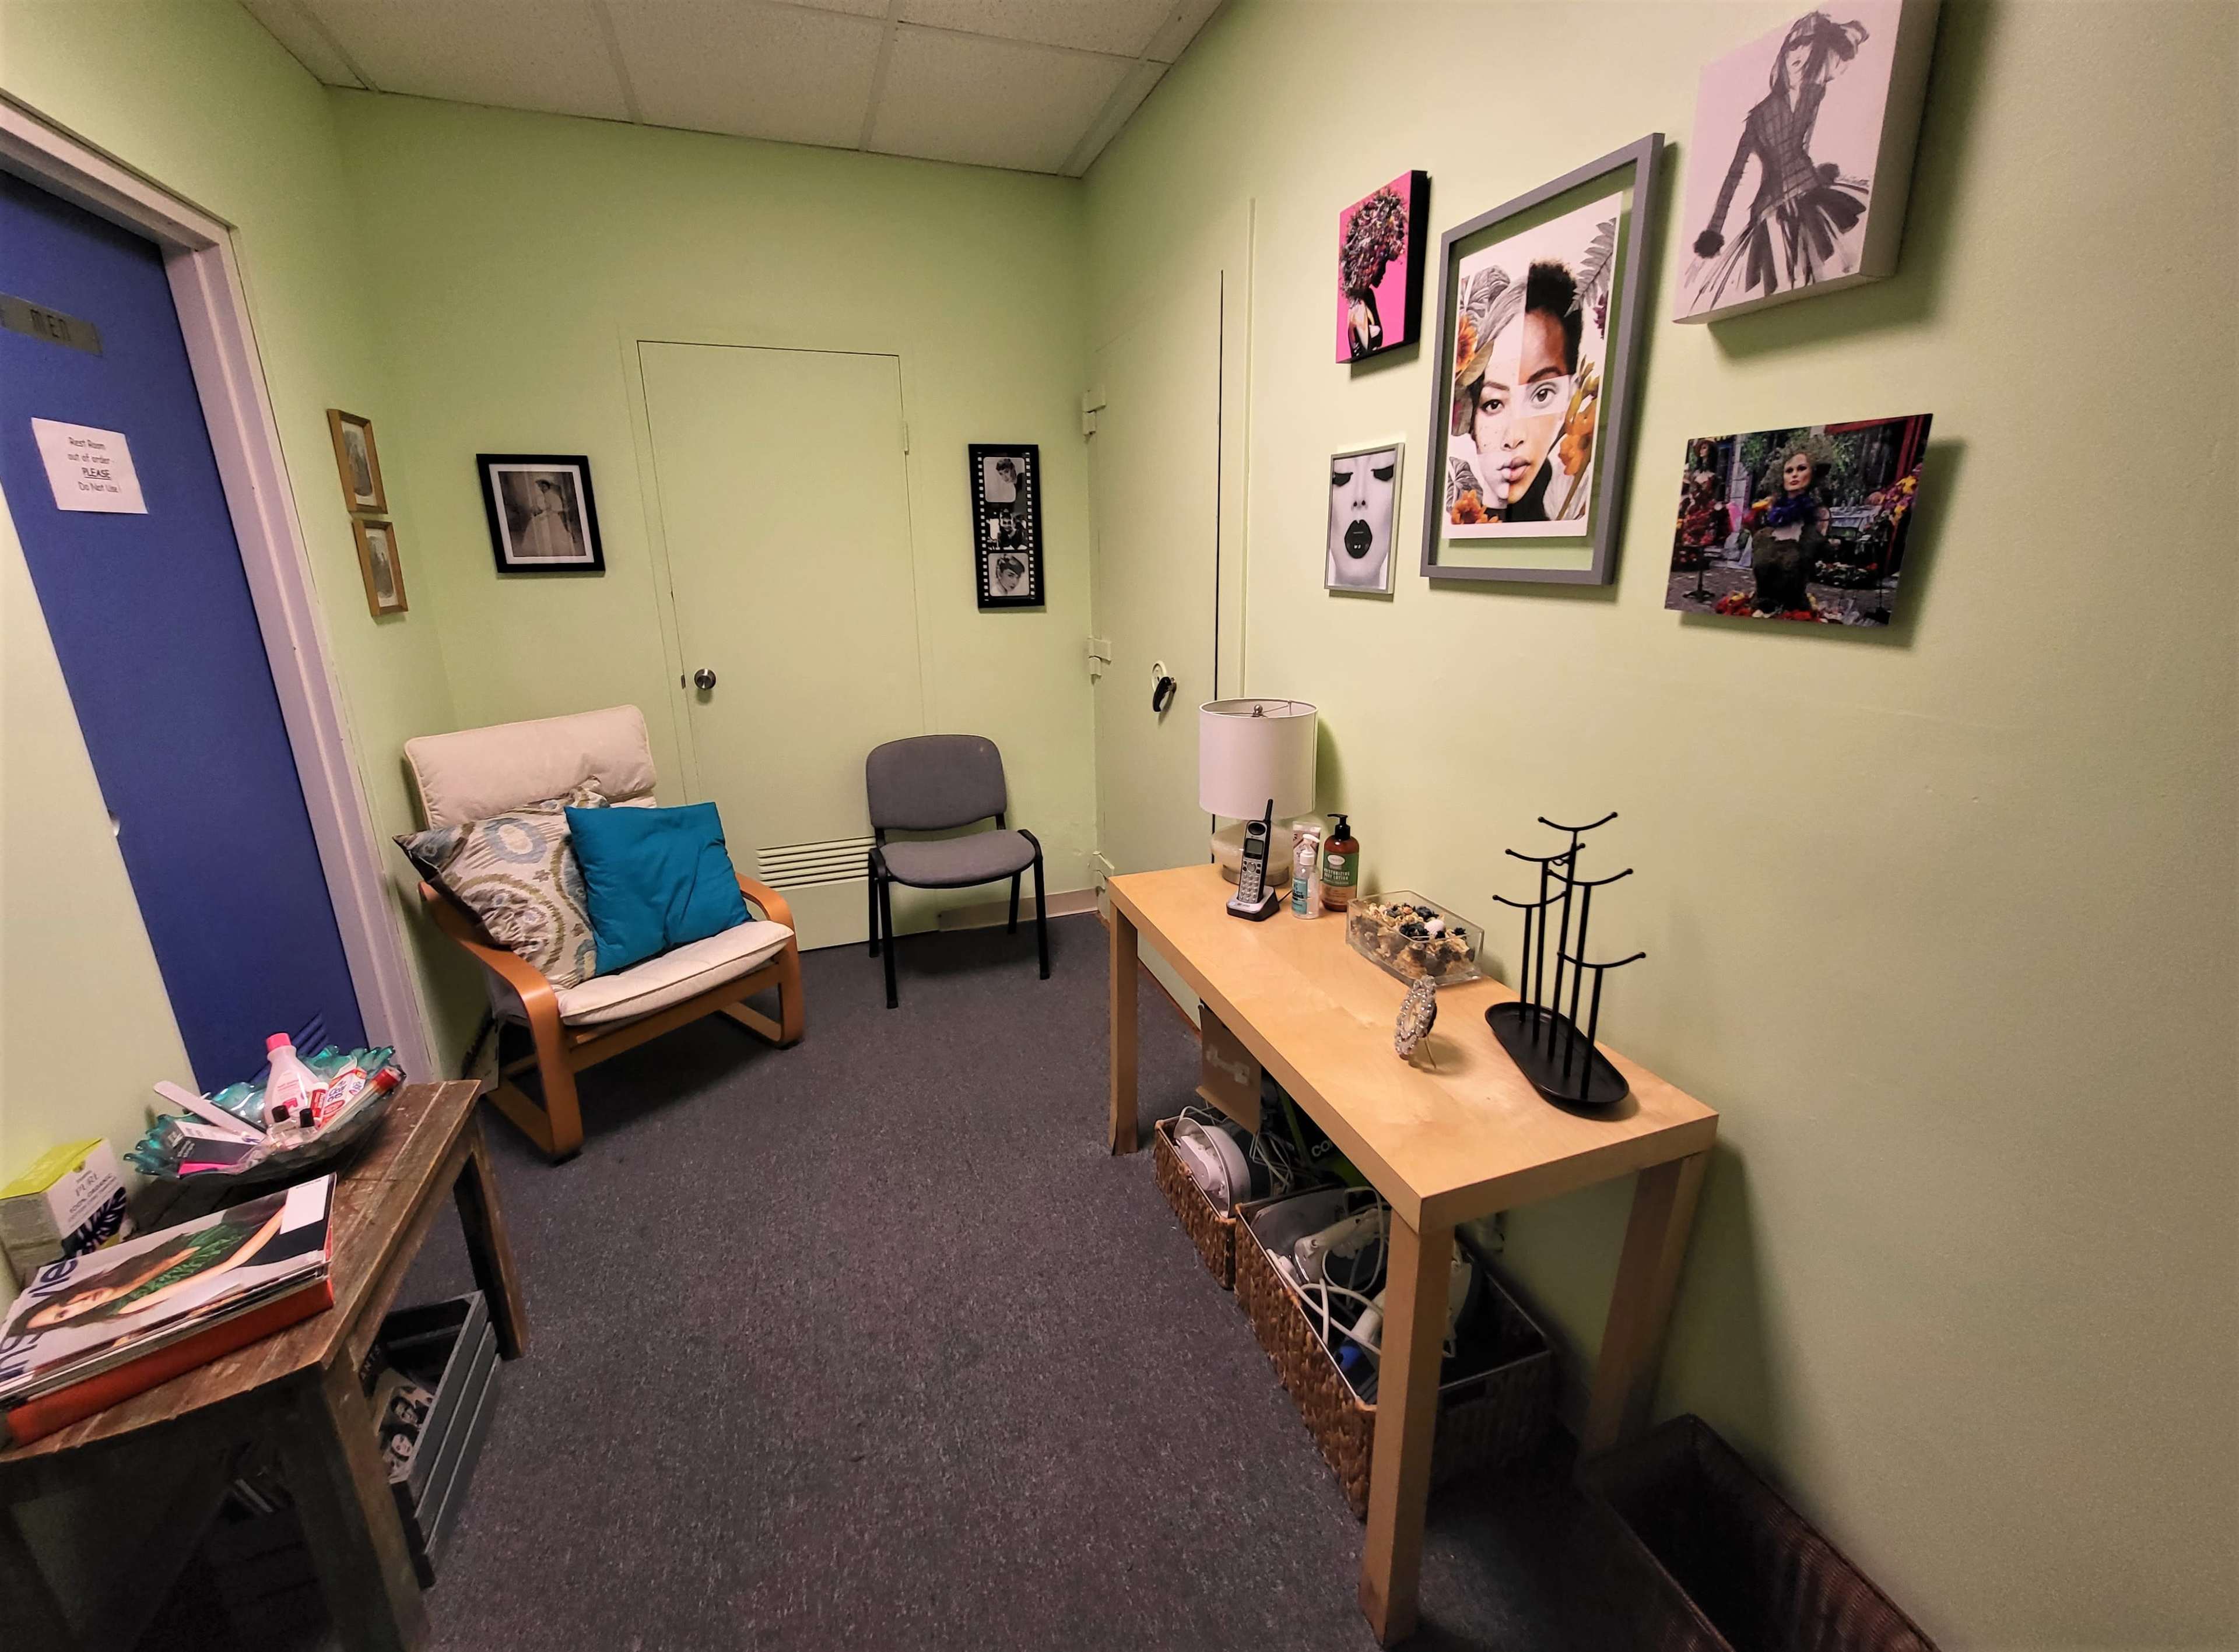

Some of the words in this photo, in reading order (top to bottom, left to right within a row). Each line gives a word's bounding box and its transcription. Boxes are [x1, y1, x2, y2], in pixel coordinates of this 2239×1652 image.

[30, 309, 72, 341] MEN
[87, 439, 106, 449] Room
[82, 467, 111, 479] PLEASE
[78, 481, 89, 491] Do
[90, 483, 104, 491] Not
